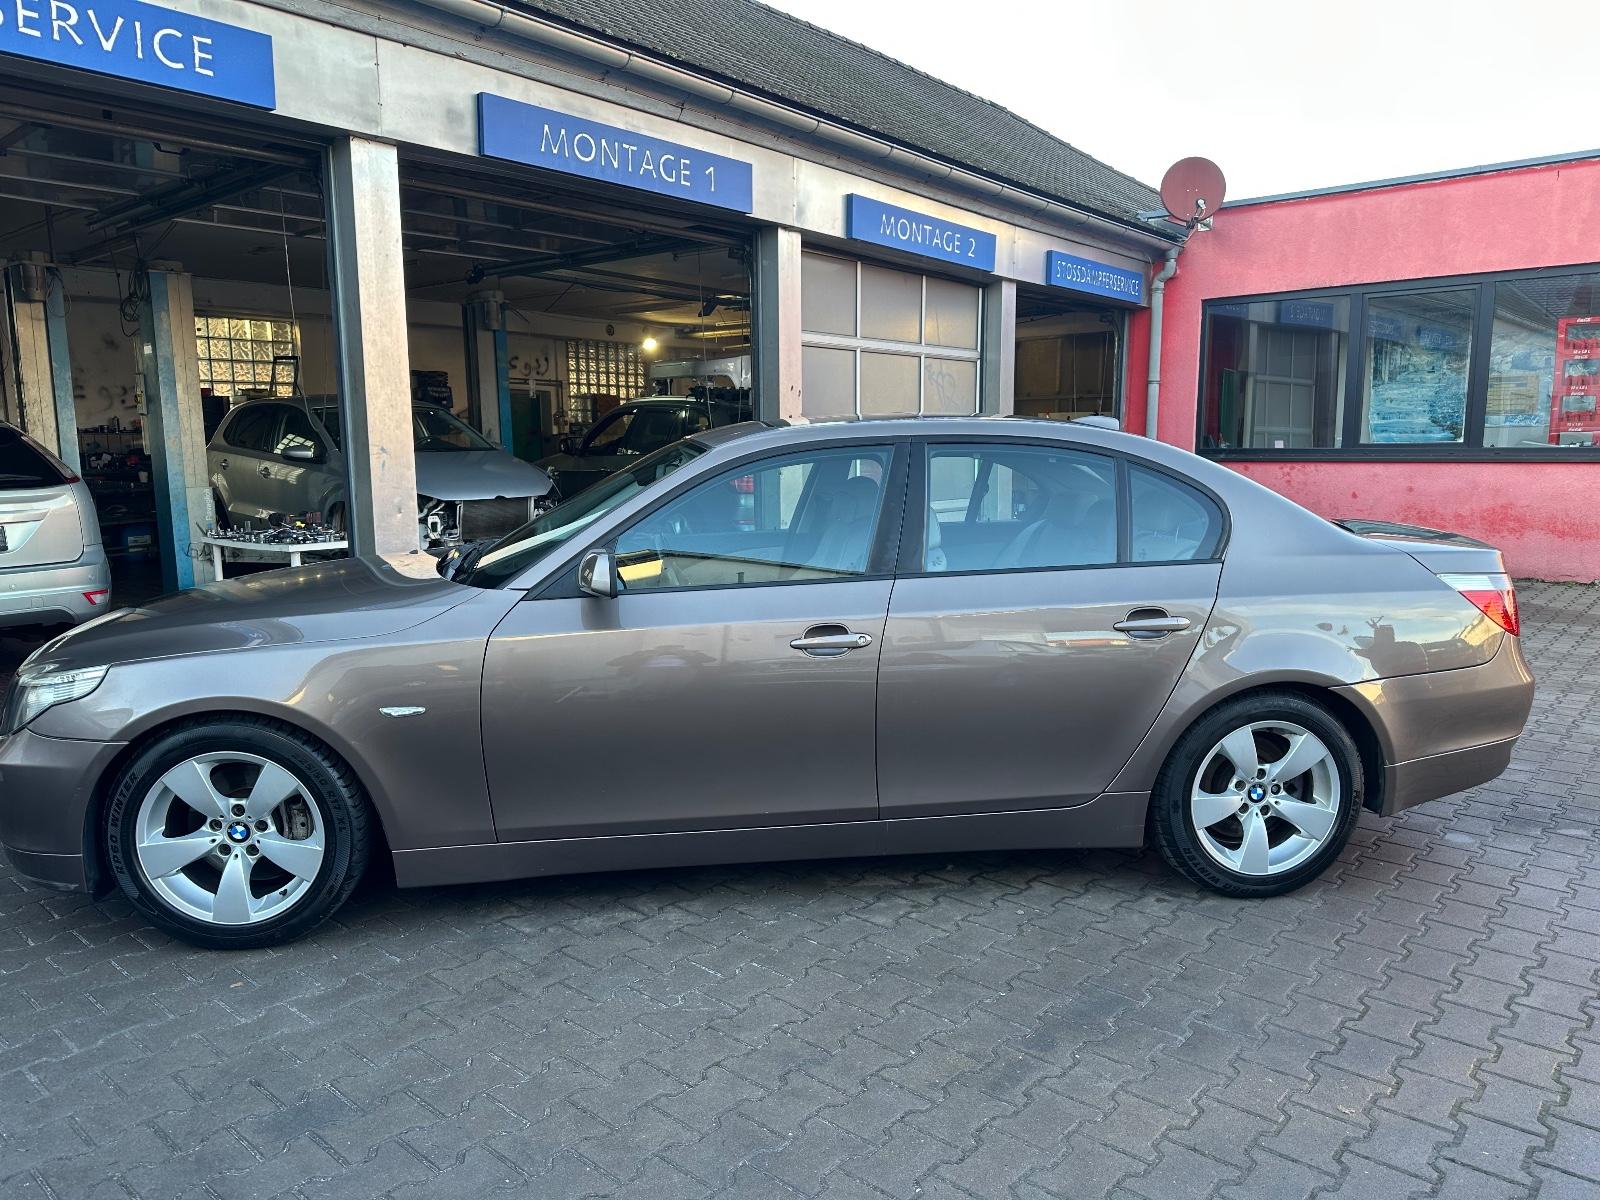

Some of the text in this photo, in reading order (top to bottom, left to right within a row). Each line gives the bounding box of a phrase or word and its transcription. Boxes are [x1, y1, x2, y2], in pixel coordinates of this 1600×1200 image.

[0, 0, 215, 77] ERVICE
[541, 124, 716, 192] MONTAGE 1
[880, 213, 976, 258] MONTAGE 2
[110, 771, 139, 828] WINTER
